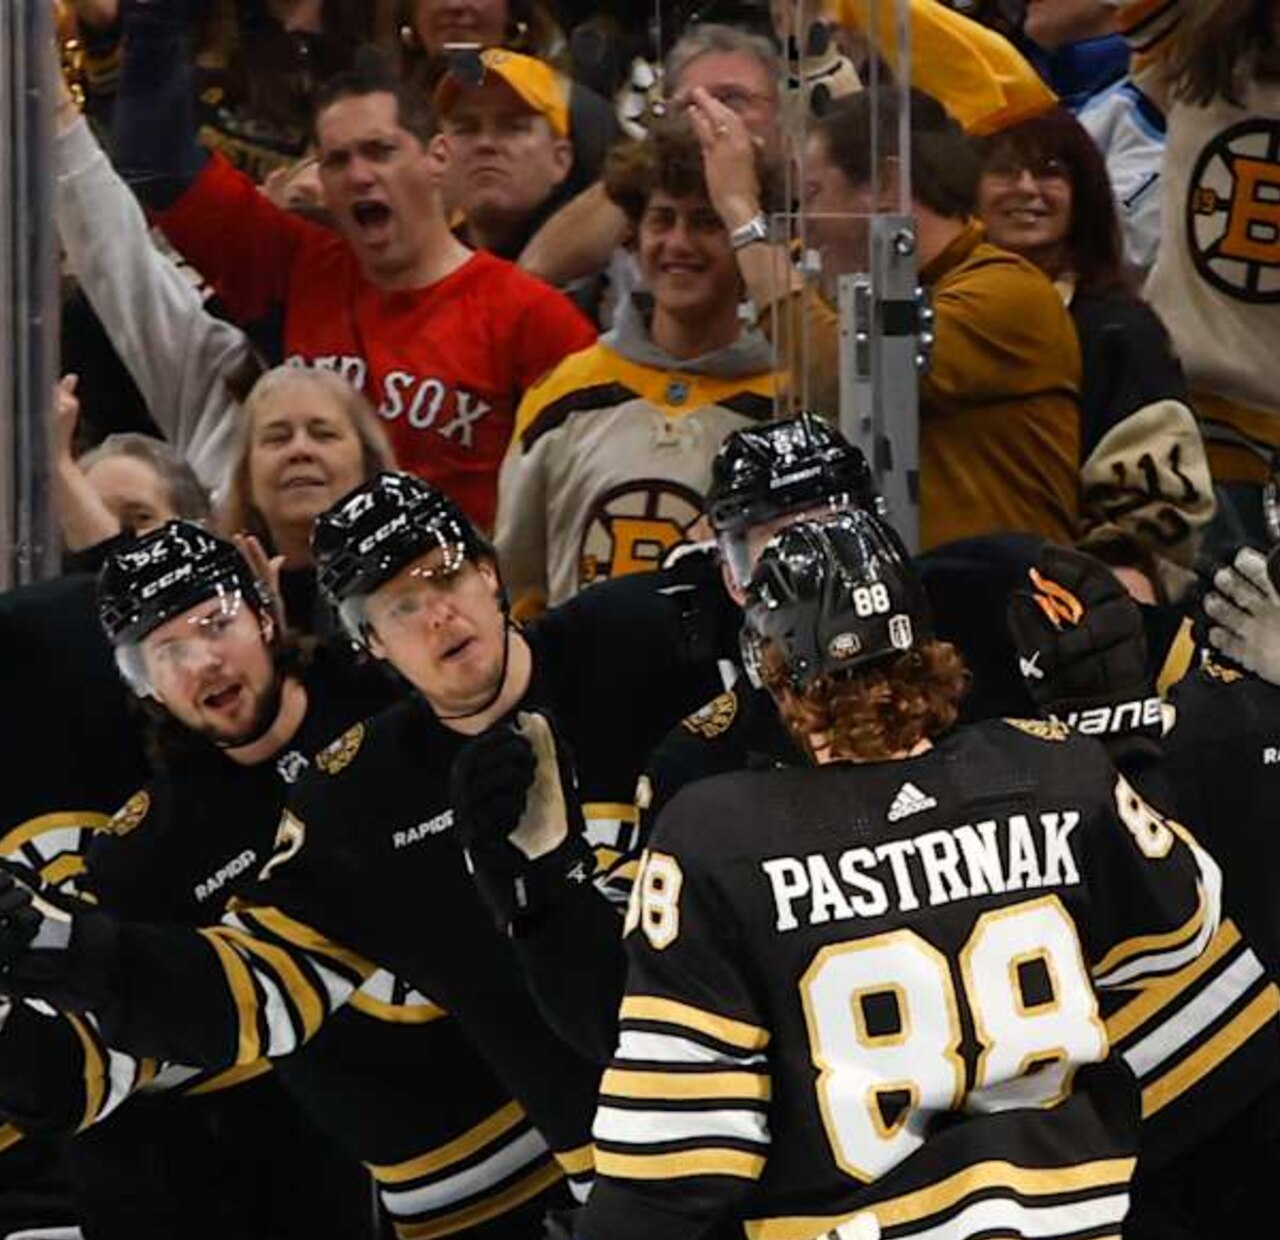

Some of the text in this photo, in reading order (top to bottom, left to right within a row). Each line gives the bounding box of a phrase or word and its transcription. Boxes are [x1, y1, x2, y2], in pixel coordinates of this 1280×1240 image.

[378, 371, 492, 448] SOX
[358, 513, 407, 554] CCM
[141, 563, 193, 599] CCM
[852, 583, 890, 617] 88
[762, 811, 1081, 933] PASTRNAK
[799, 893, 1110, 1184] 88
